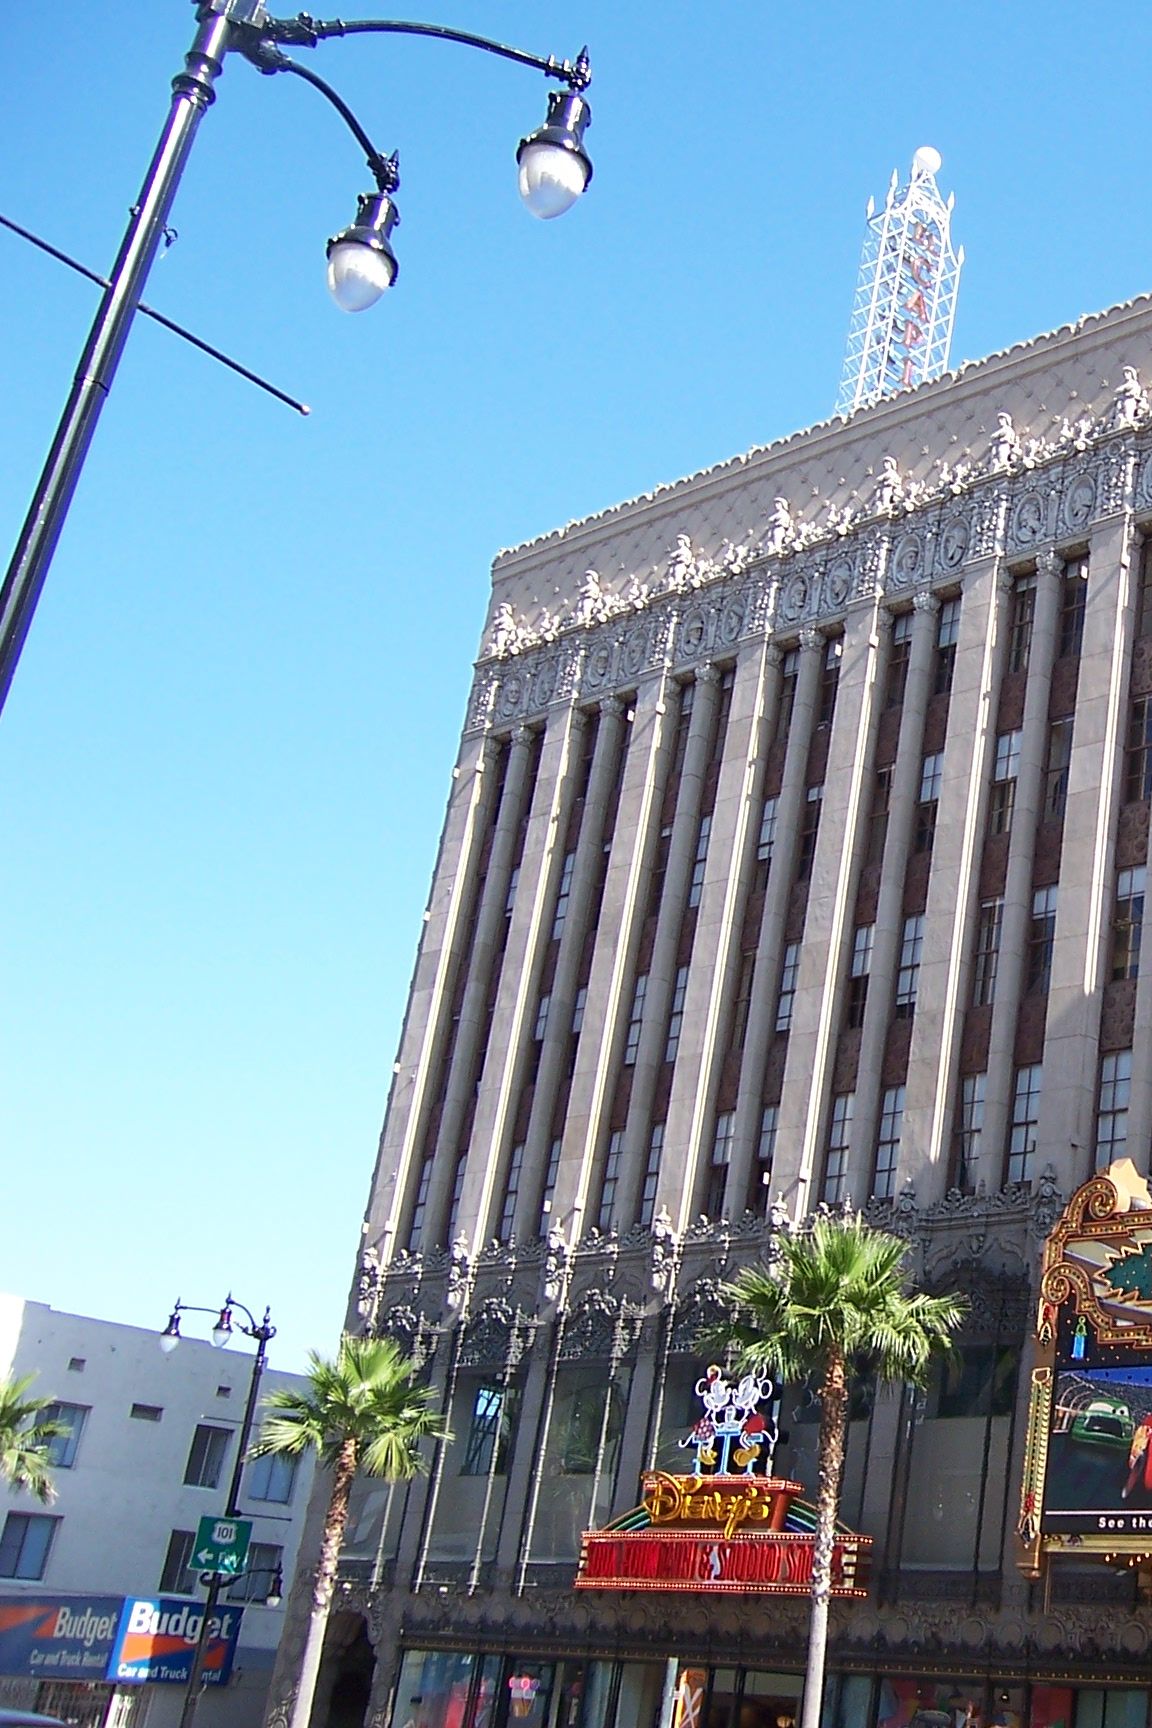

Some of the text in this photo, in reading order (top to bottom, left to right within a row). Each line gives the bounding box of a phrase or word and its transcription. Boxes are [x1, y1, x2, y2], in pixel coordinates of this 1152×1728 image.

[640, 1470, 771, 1541] Disney's
[1098, 1517, 1125, 1529] See
[217, 1526, 233, 1540] 101
[53, 1606, 118, 1647] Budget
[127, 1601, 233, 1644] Budget
[30, 1649, 45, 1665] Car
[43, 1653, 60, 1666] and
[59, 1650, 82, 1666] Truck
[118, 1663, 138, 1677] Car
[138, 1666, 158, 1678] and
[160, 1666, 188, 1679] Truck
